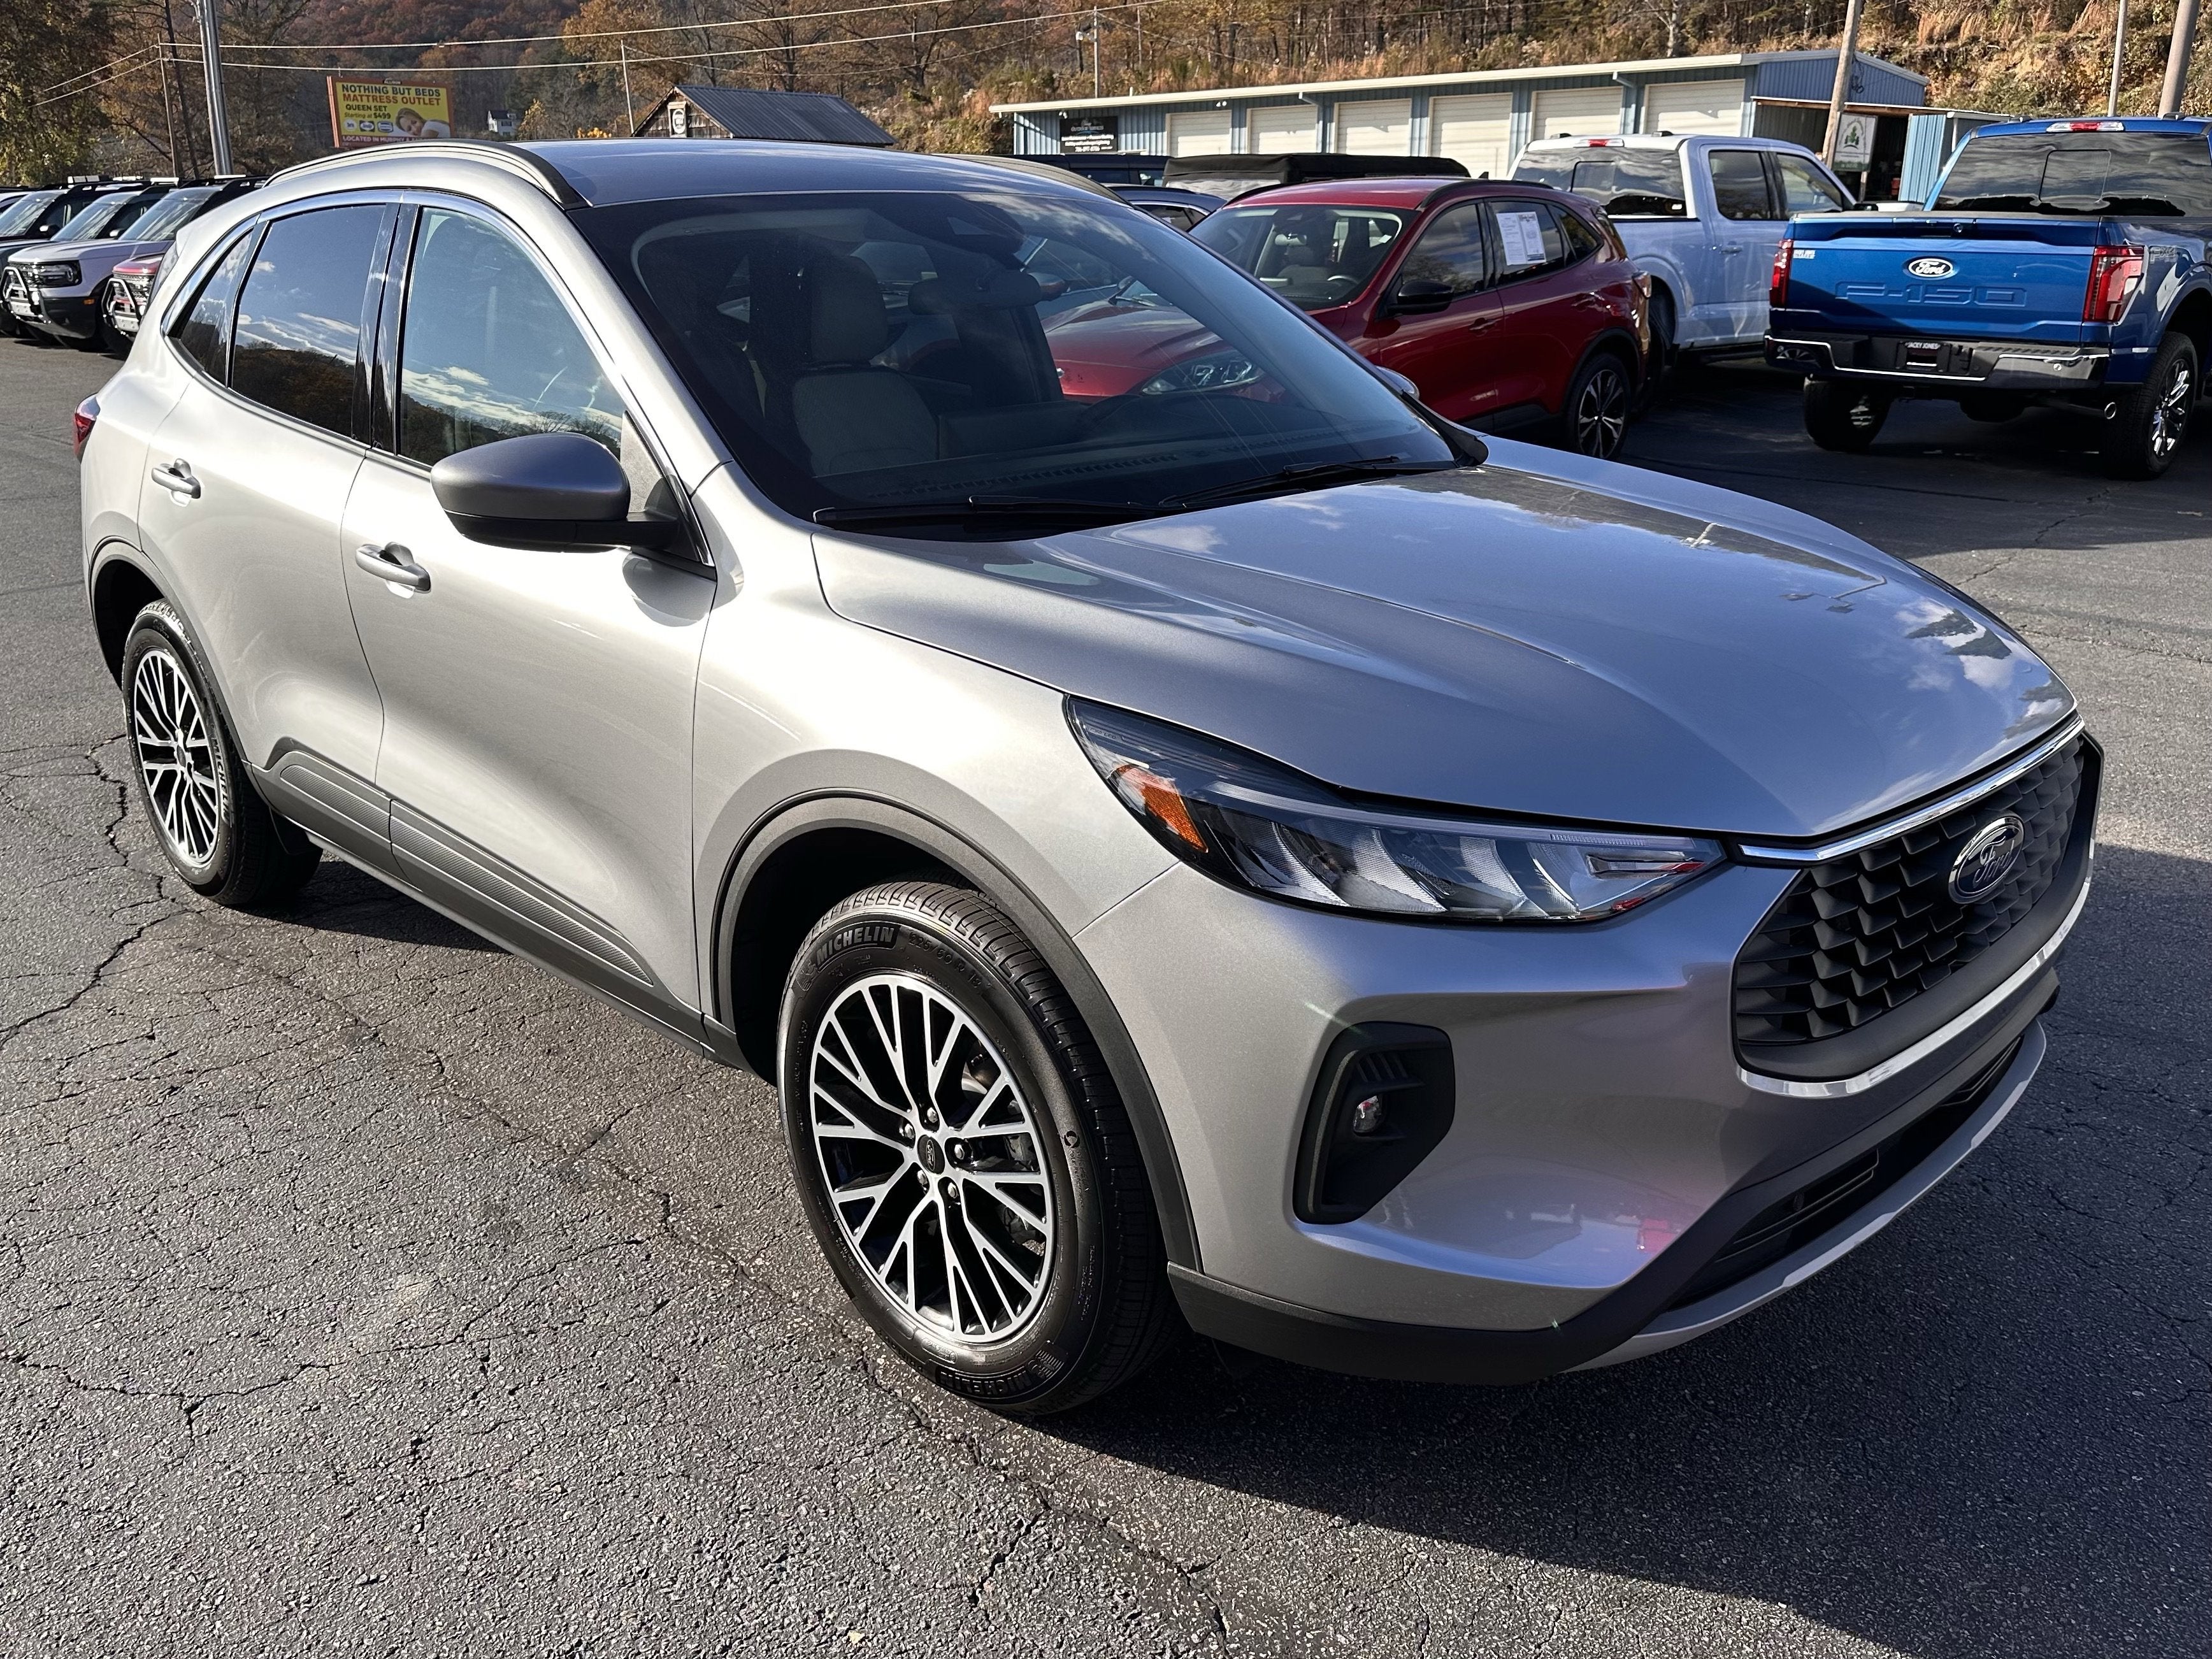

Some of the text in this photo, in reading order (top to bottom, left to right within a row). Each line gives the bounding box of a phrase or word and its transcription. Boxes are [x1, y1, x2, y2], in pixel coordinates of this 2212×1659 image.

[341, 84, 440, 97] NOTHING BUT BEDS
[343, 94, 441, 105] MATTRESS OUTLET
[1916, 261, 1947, 275] Ford
[1835, 281, 2027, 307] F-150
[816, 926, 894, 965] MICHELIN
[908, 933, 953, 965] 225/60
[939, 1370, 1033, 1395] MICHELIN
